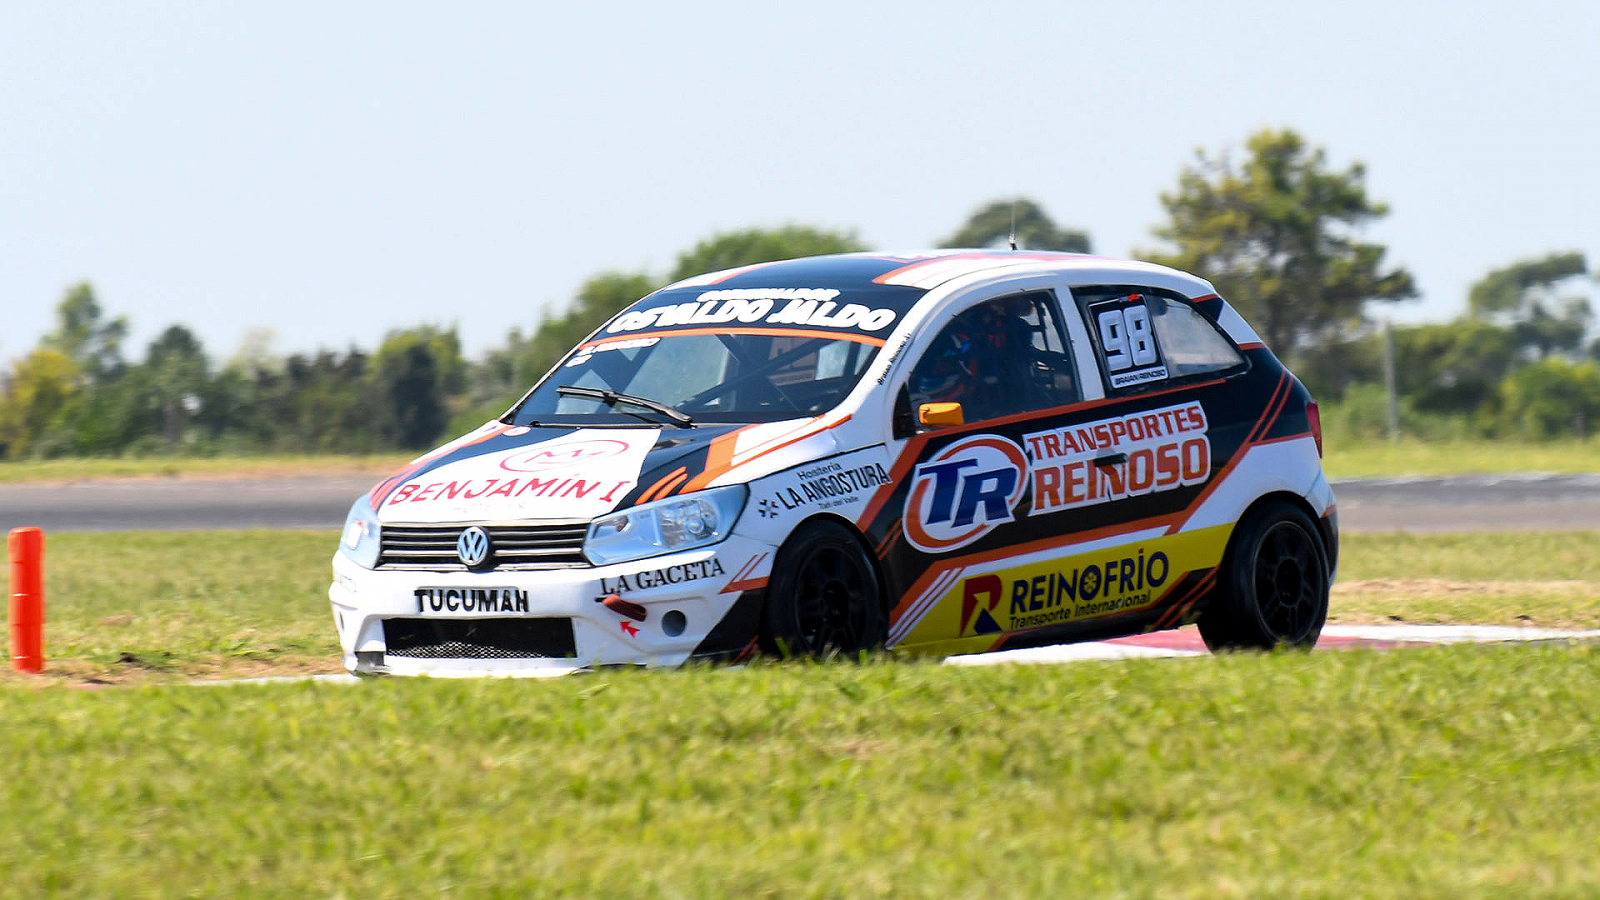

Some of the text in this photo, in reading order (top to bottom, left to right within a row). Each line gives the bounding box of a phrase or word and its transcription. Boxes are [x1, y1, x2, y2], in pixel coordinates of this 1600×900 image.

[607, 299, 897, 334] OSVALDO JALDO
[1098, 304, 1157, 371] 98
[1027, 405, 1206, 460] TRANSPORTES
[389, 474, 631, 505] BENJAMÍN I
[775, 462, 889, 511] LA ANGOSTURA
[919, 458, 1018, 528] TR
[1033, 438, 1209, 510] REINOSO
[600, 558, 726, 595] LA GACETA
[413, 588, 529, 613] TUCUMAN
[1009, 592, 1150, 631] Transporte Internacional
